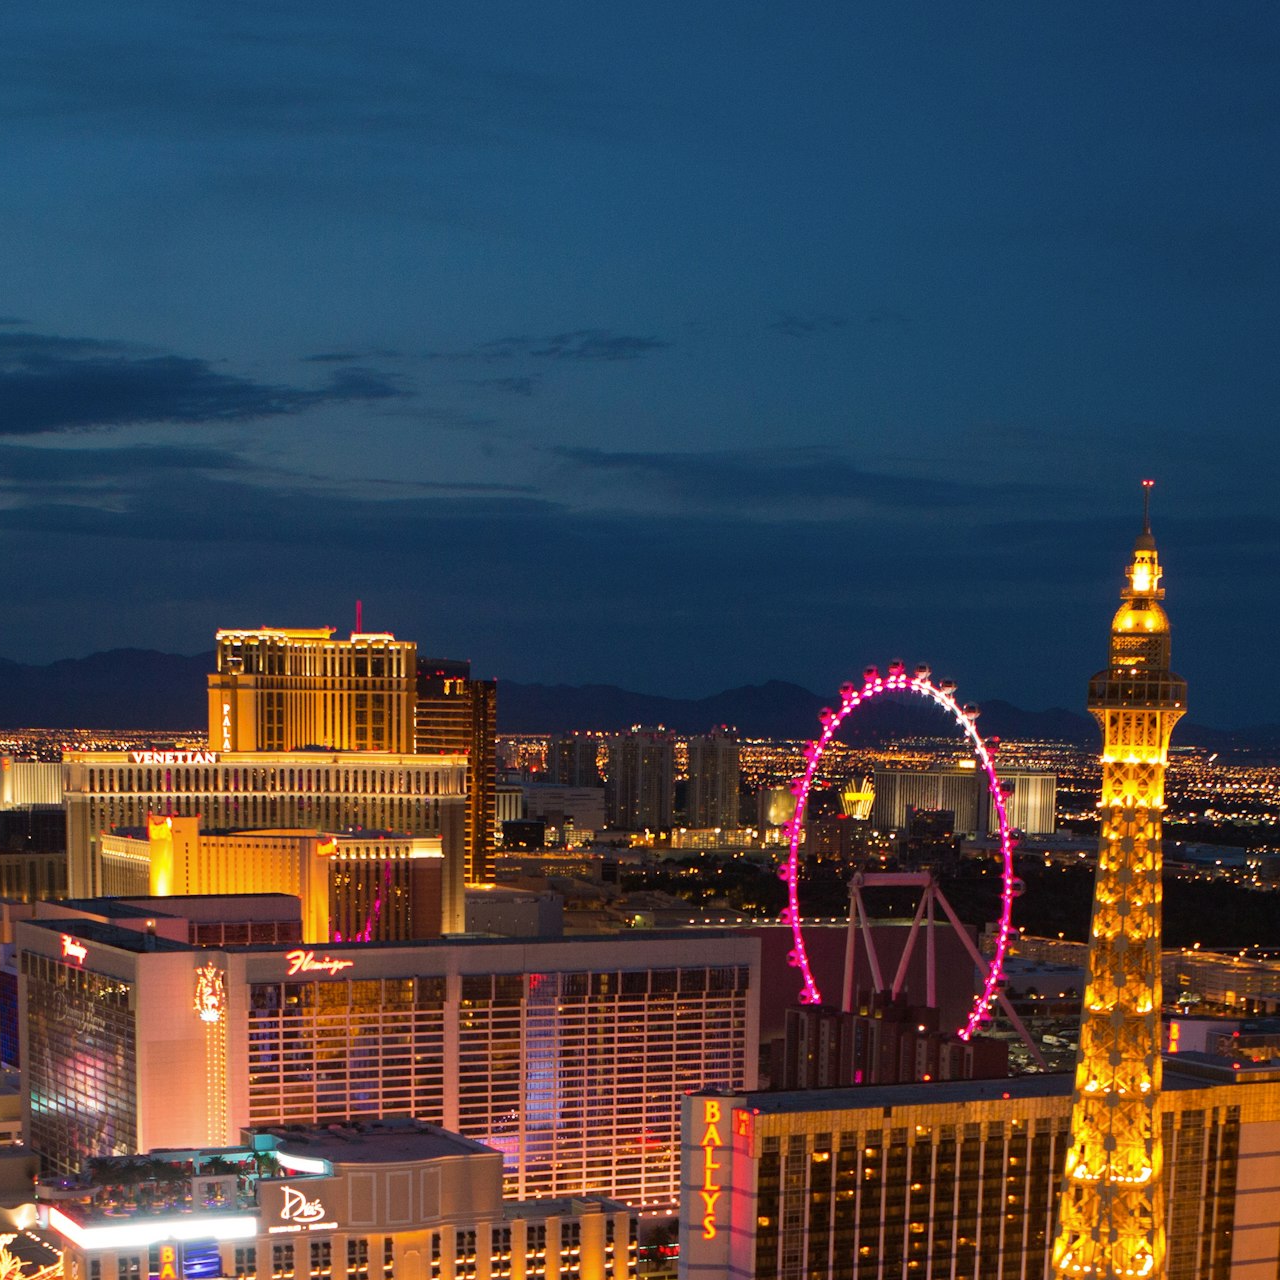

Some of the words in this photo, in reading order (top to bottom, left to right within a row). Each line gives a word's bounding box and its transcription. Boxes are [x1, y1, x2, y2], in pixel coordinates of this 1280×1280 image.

[222, 704, 231, 752] PALA
[132, 752, 217, 764] VENETIAN
[285, 949, 353, 976] Flamingo
[700, 1100, 723, 1240] BALLYS
